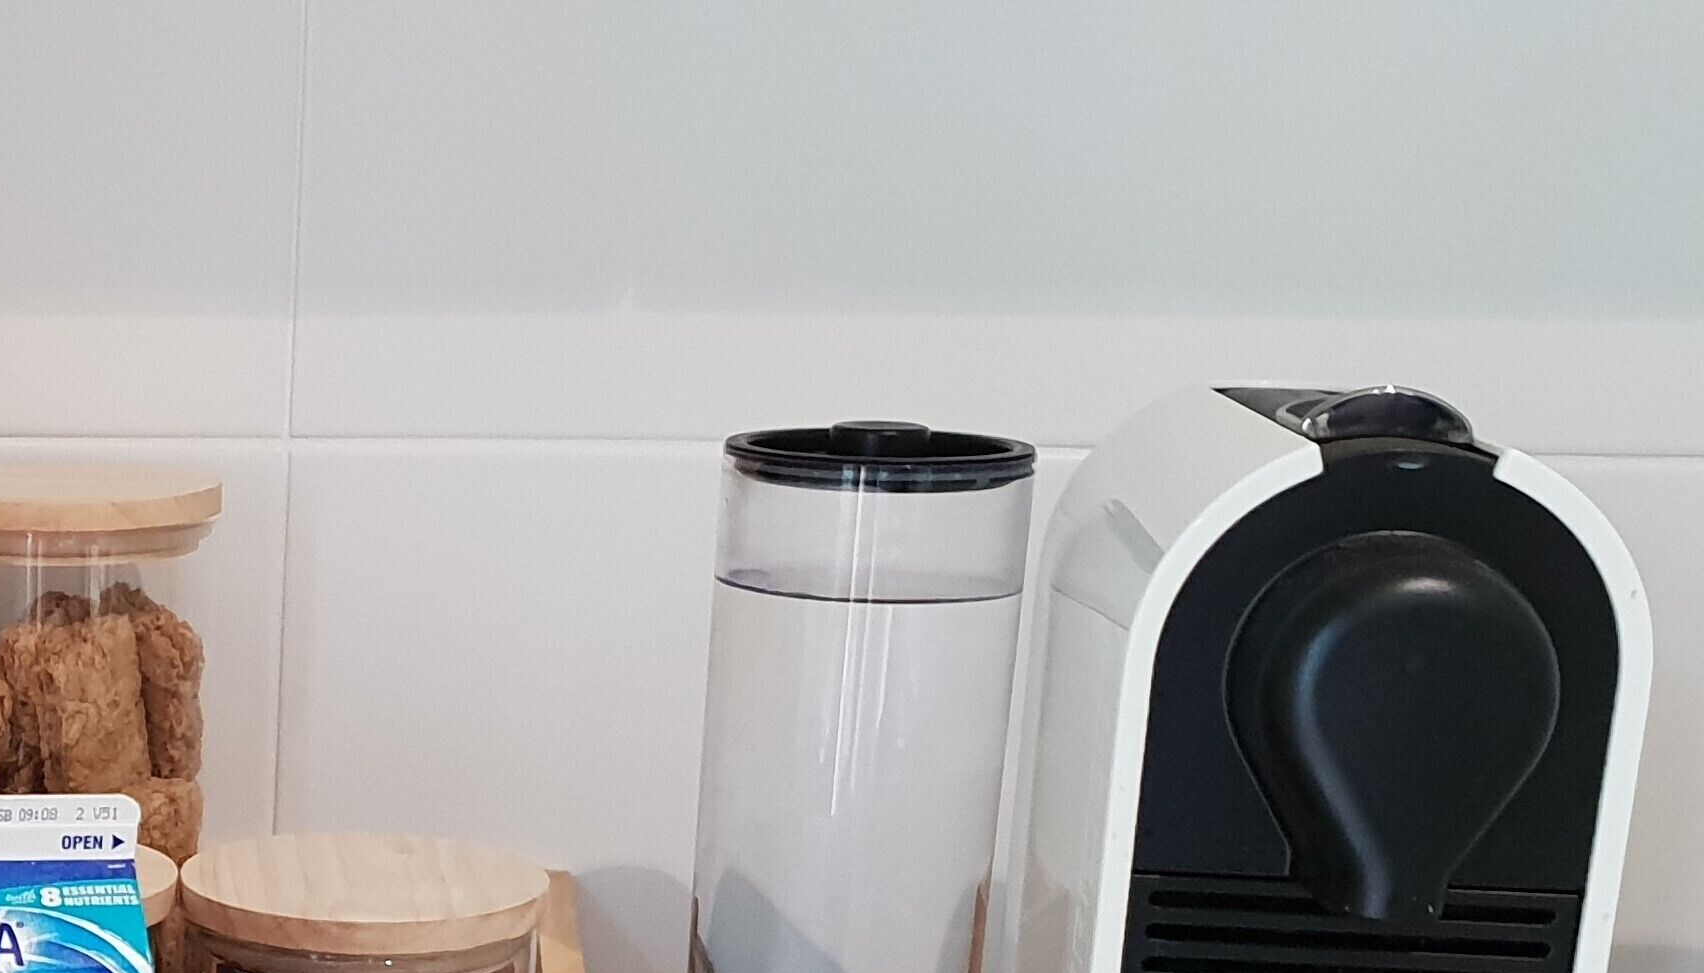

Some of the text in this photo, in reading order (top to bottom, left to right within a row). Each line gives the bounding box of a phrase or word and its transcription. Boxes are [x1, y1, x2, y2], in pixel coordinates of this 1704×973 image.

[75, 807, 85, 821] 2
[61, 835, 104, 850] OPEN
[39, 886, 63, 908] 8
